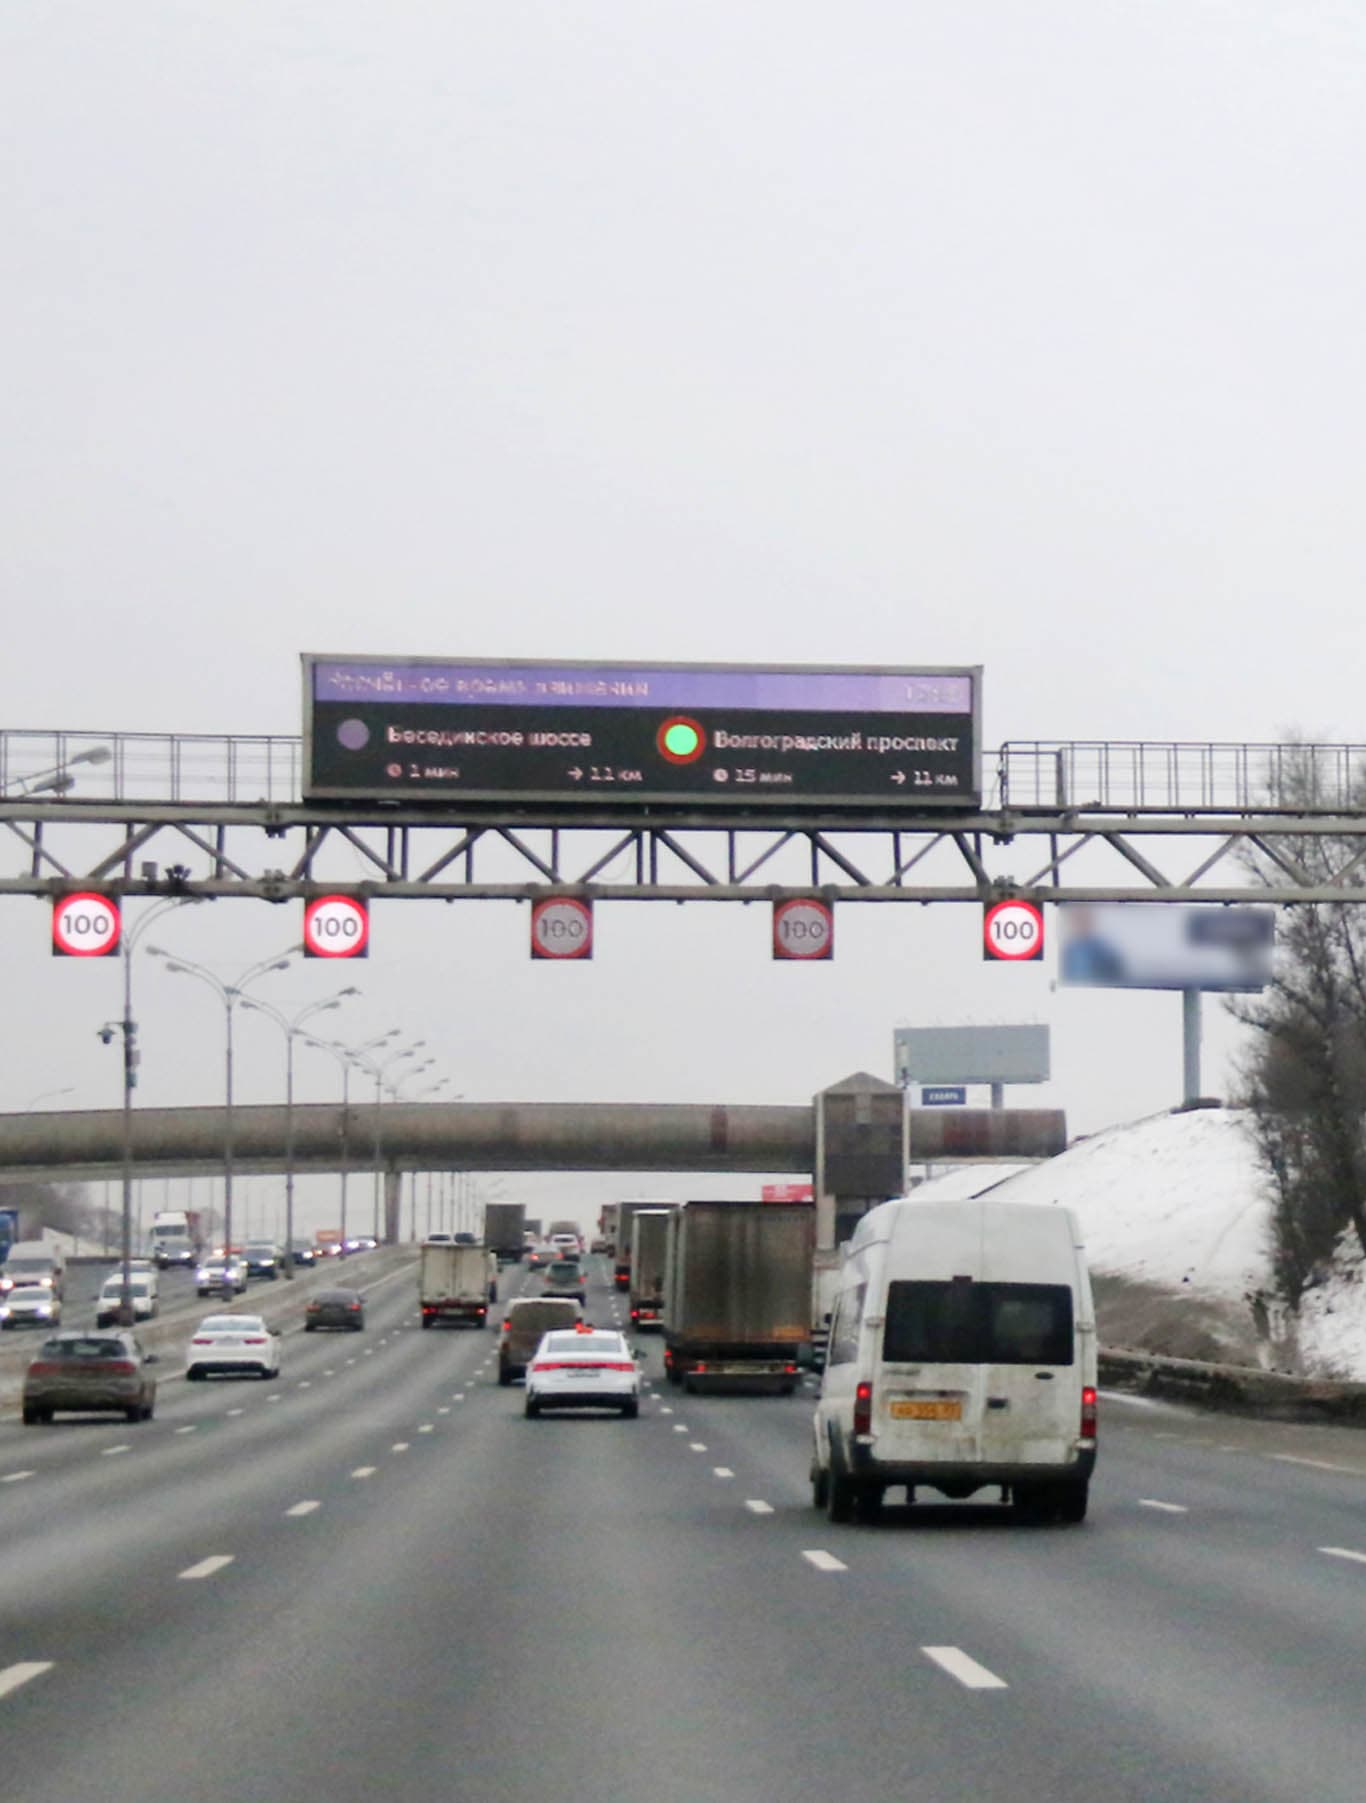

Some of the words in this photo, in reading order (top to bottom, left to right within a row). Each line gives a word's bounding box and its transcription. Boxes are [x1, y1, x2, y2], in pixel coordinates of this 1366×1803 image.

[529, 732, 592, 747] шоссе
[714, 731, 862, 752] Волгоградский
[867, 736, 959, 753] проспект
[63, 915, 109, 935] 100
[314, 917, 358, 937] 100
[541, 919, 584, 938] 100
[782, 920, 824, 939] 100
[993, 921, 1034, 940] 100
